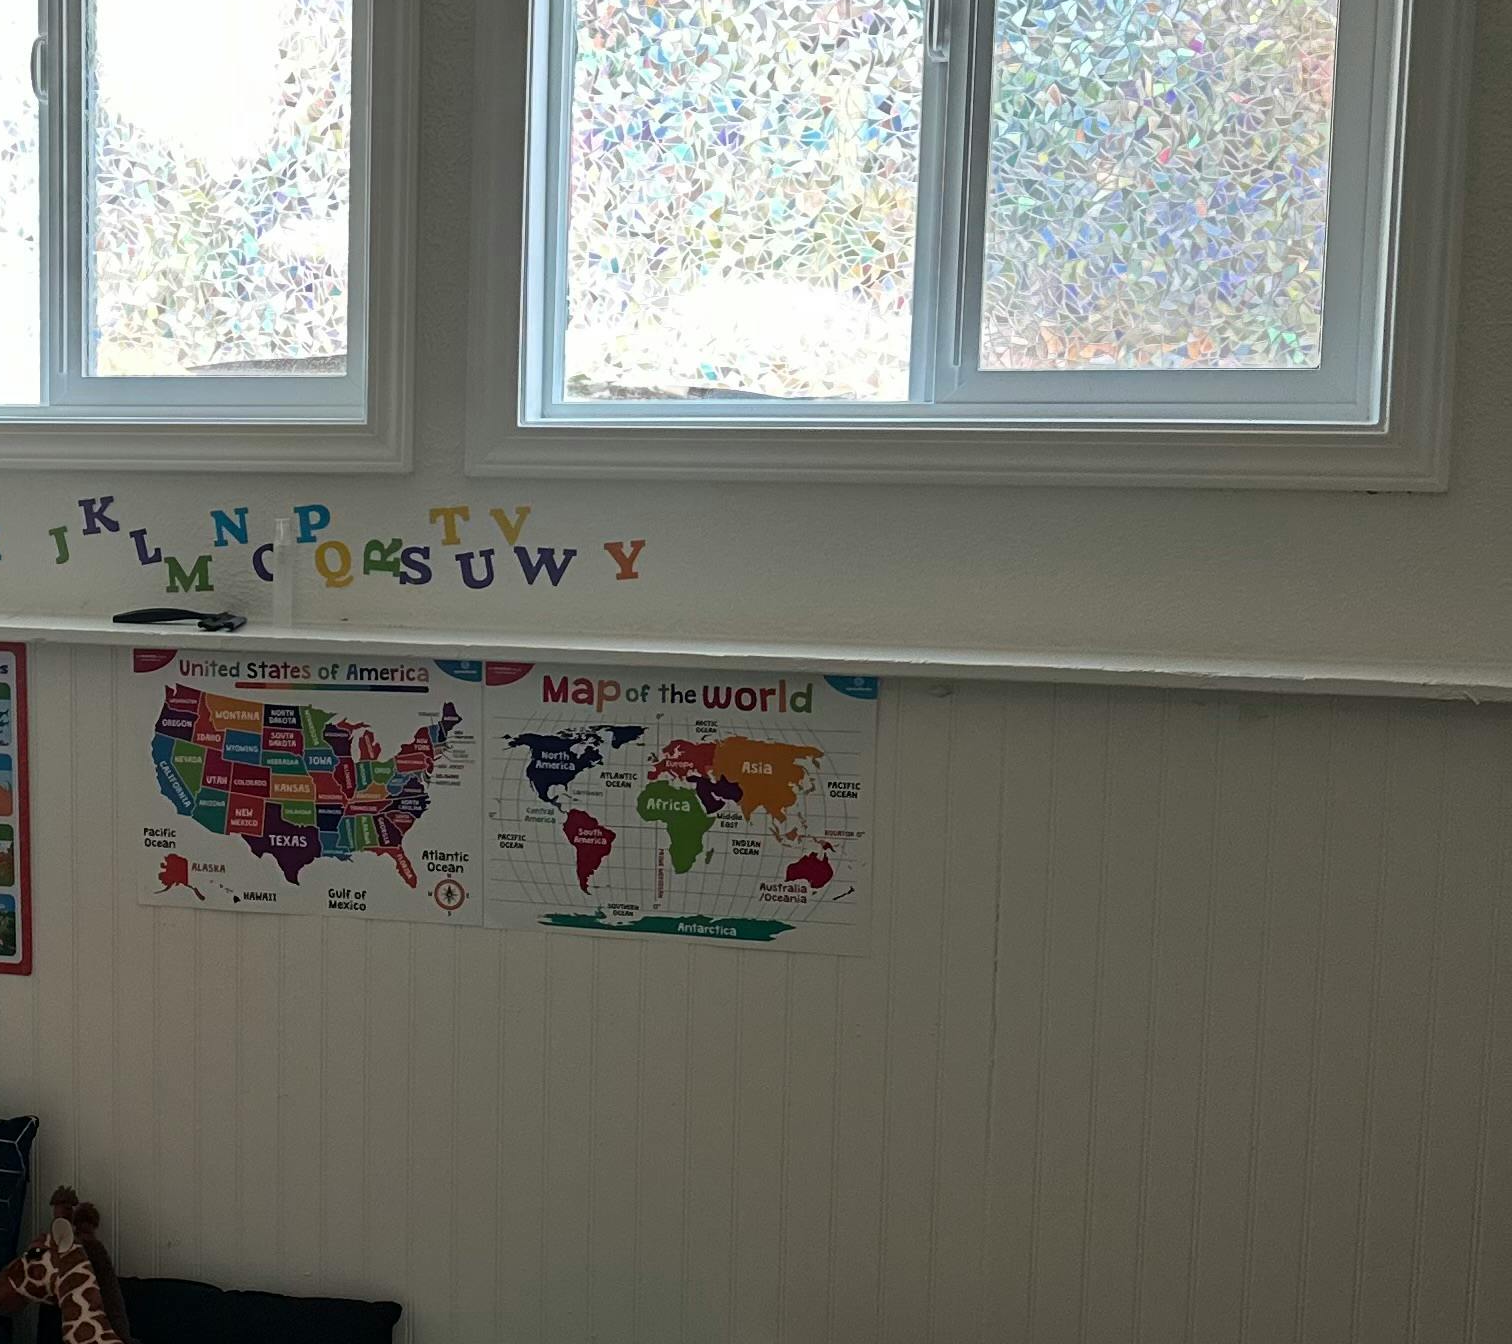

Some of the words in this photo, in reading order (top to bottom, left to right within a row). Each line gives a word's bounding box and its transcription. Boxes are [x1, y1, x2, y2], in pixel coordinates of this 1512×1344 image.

[78, 495, 120, 536] K
[210, 507, 249, 548] N
[293, 504, 331, 543] P
[429, 505, 470, 546] T
[490, 505, 531, 546] V
[48, 525, 69, 565] J
[129, 528, 162, 565] L
[314, 540, 355, 588] Q
[400, 546, 432, 585] S
[513, 545, 577, 586] W
[604, 539, 646, 581] Y
[164, 555, 215, 593] M
[455, 548, 495, 589] U
[179, 659, 240, 678] United
[246, 662, 312, 680] States
[318, 663, 340, 680] of
[345, 663, 429, 682] America
[542, 675, 621, 713] Map
[625, 684, 650, 703] of
[658, 683, 697, 704] the
[702, 679, 813, 713] world
[215, 710, 260, 721] MONTANA
[161, 718, 192, 728] OREGON
[308, 756, 332, 765] IOWA
[541, 750, 570, 761] North
[535, 759, 576, 771] America
[741, 761, 773, 775] Asia
[273, 783, 311, 793] KANSAS
[827, 781, 861, 790] PACIFIC
[829, 790, 858, 799] OCEAN
[646, 797, 690, 812] Africa
[143, 827, 176, 838] Pacific
[144, 838, 176, 849] Ocean
[268, 834, 308, 848] TEXAS
[731, 839, 761, 848] INDIAN
[421, 850, 469, 863] Atlantic
[733, 847, 759, 856] OCEAN
[427, 862, 464, 873] Ocean
[328, 888, 351, 900] Gulf
[355, 890, 367, 900] of
[759, 882, 807, 894] Australia
[243, 892, 277, 902] HAWAII
[759, 892, 807, 904] /Oceania
[328, 899, 367, 911] Mexico
[677, 922, 737, 936] Antarctica
